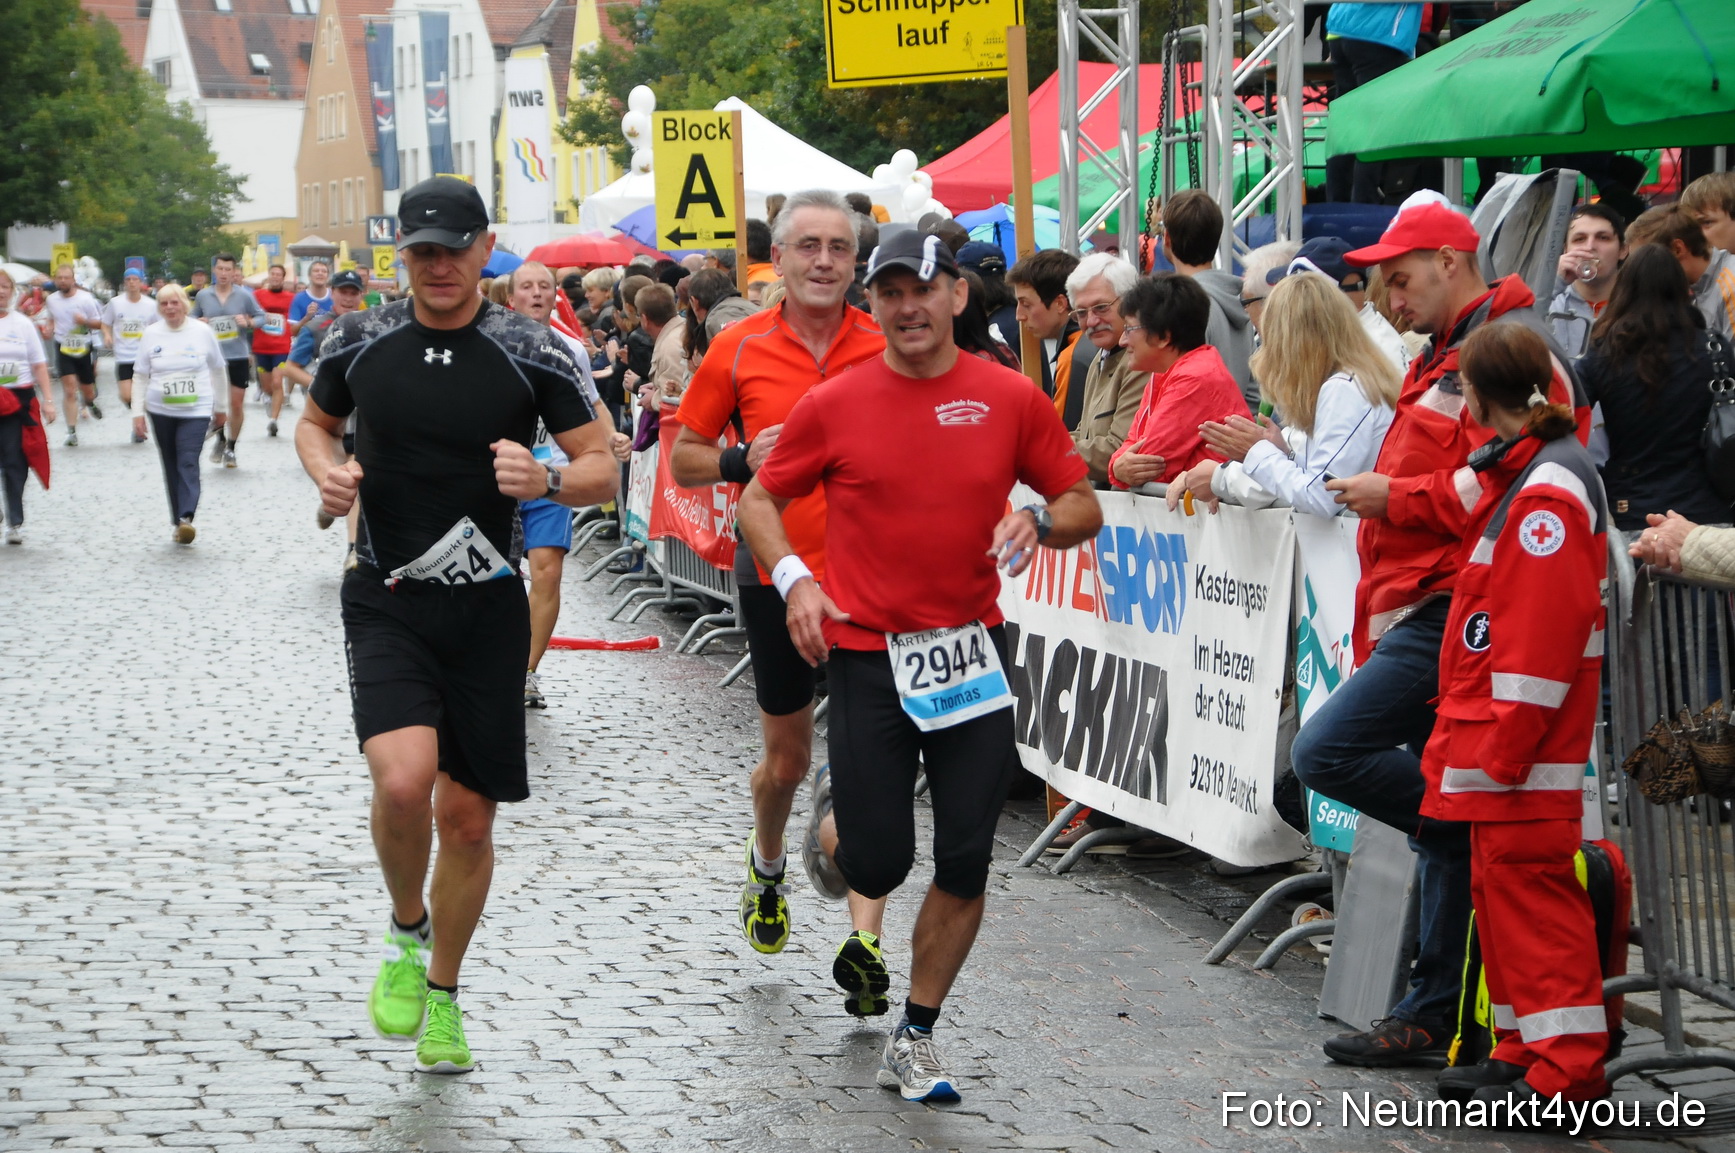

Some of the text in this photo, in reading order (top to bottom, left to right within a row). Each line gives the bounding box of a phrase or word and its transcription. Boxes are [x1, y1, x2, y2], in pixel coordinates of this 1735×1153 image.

[838, 0, 990, 14] Schnupp
[897, 20, 950, 47] lauf
[662, 117, 732, 141] Block
[675, 153, 726, 219] A
[378, 256, 390, 272] C
[123, 323, 138, 332] 222
[214, 322, 232, 332] 424
[540, 344, 573, 368] UNDER
[163, 380, 196, 395] 5178
[1525, 513, 1561, 531] DEUTSCHES
[1523, 532, 1561, 553] ROTES KREUZ
[416, 539, 463, 575] Neumarkt
[422, 544, 493, 586] 54
[1195, 564, 1268, 619] Kastengass
[905, 632, 988, 691] 2944
[1194, 634, 1255, 684] Im Herzen
[930, 687, 982, 713] Thomas
[1195, 683, 1246, 732] der Stadt
[1189, 753, 1225, 799] 92318
